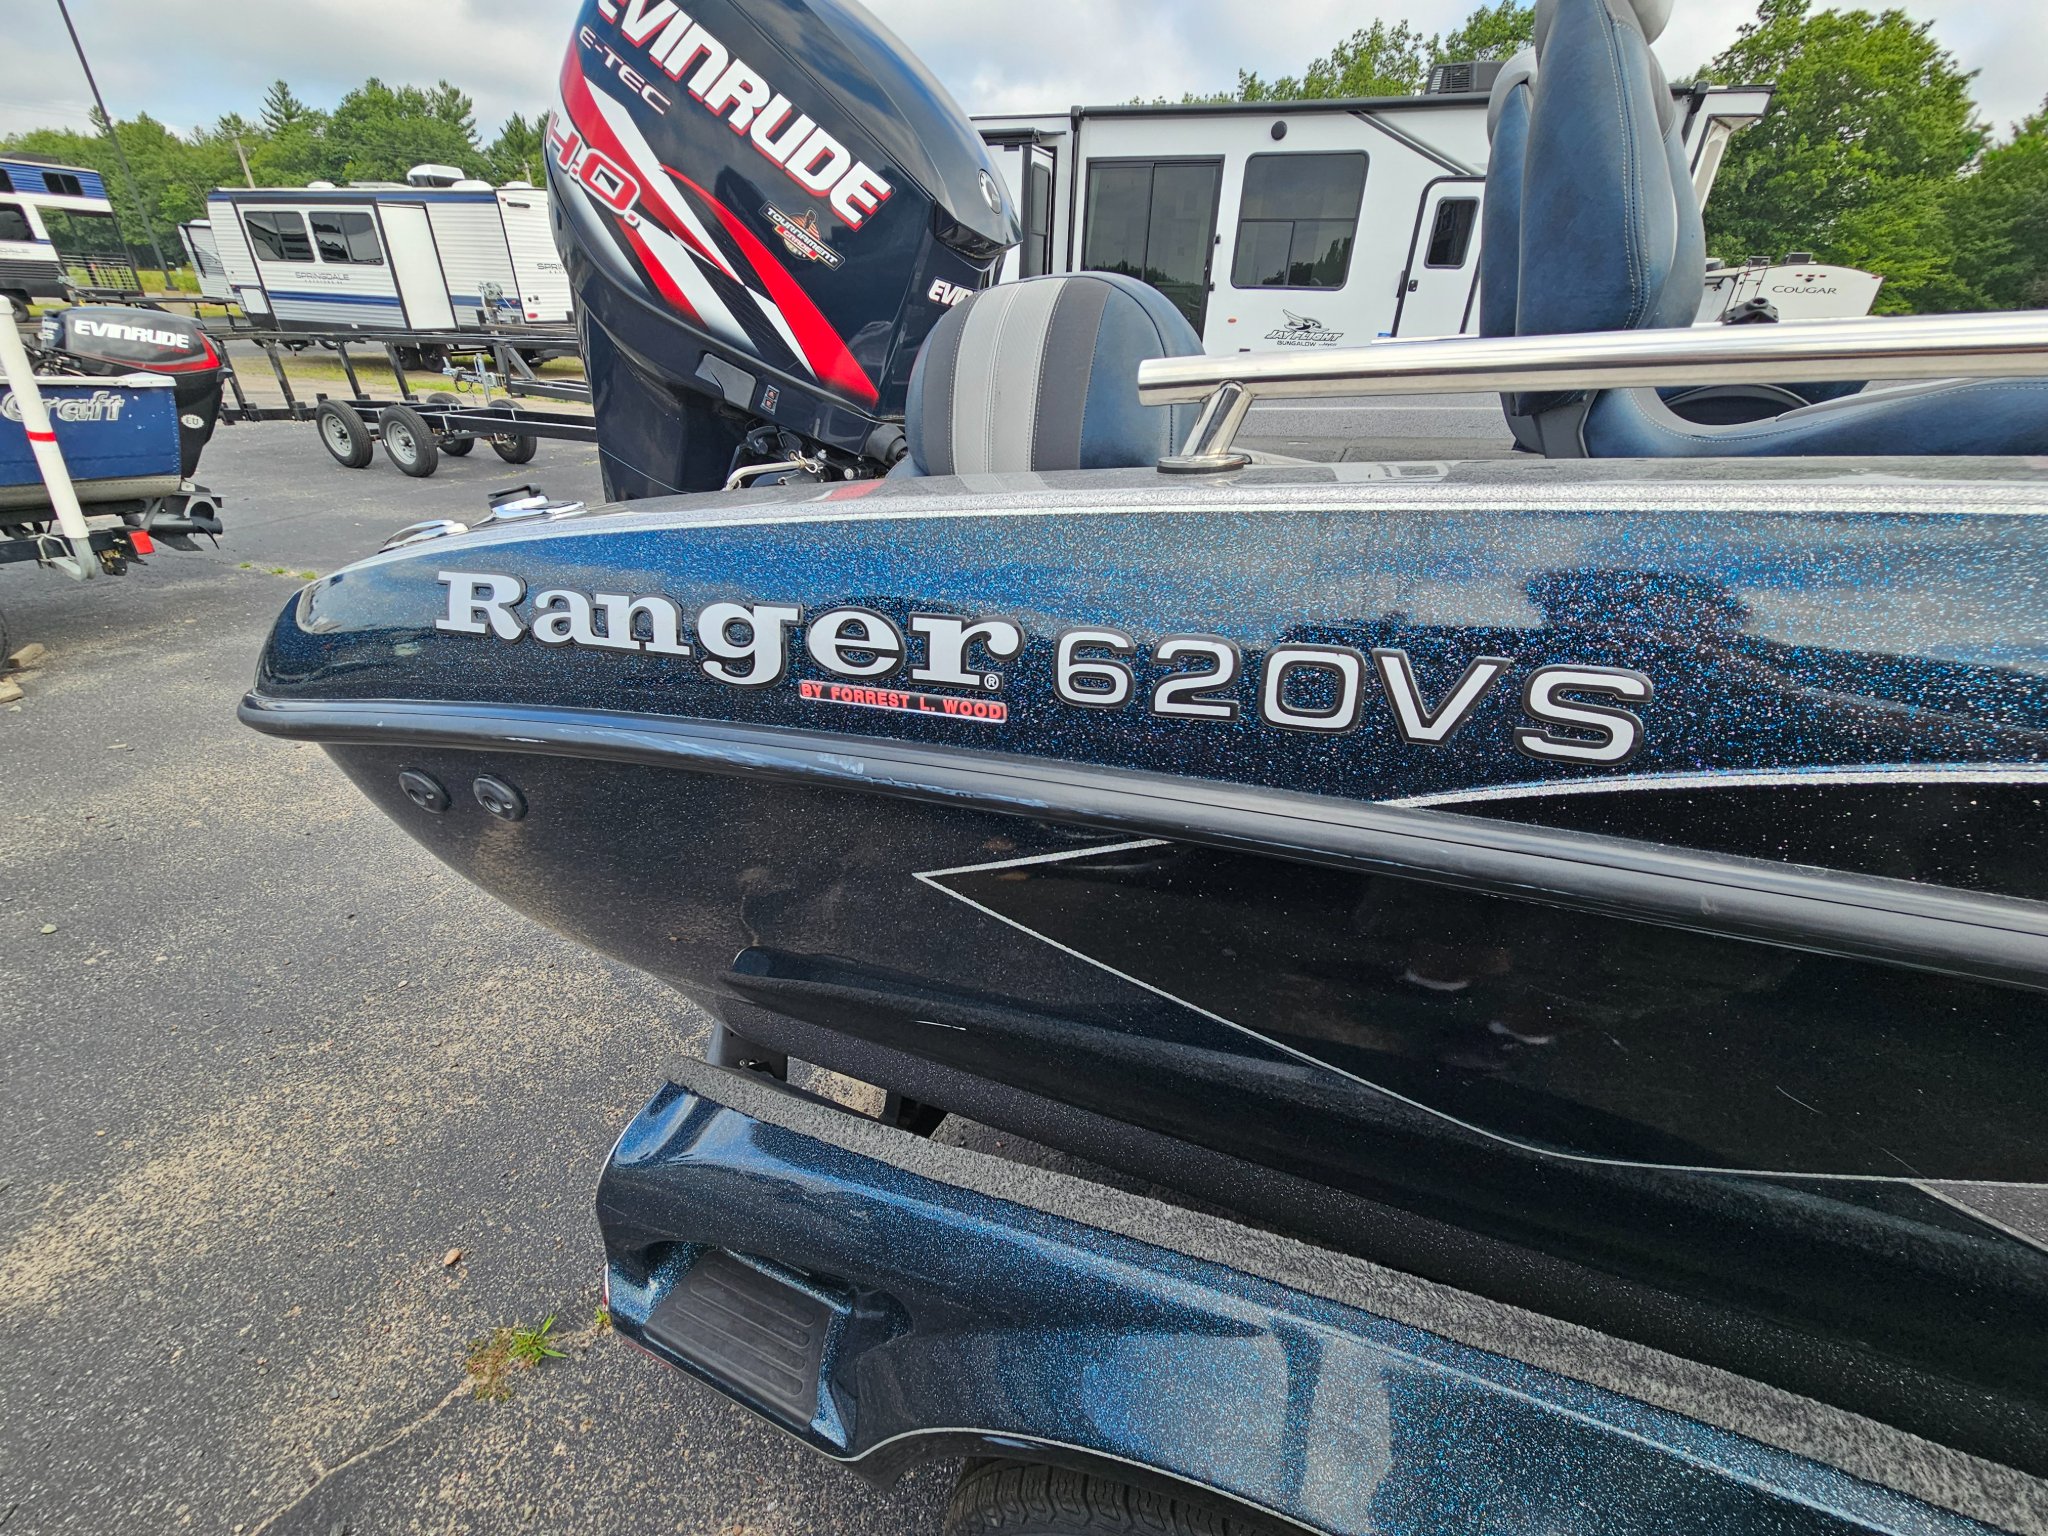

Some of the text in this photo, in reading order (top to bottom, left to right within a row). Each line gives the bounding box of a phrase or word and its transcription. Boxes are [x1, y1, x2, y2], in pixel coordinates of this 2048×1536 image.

[579, 25, 672, 116] E-TEC
[767, 206, 839, 263] TOURNAMENT
[1772, 285, 1838, 295] COUGAR
[74, 319, 190, 348] EVINRUDE
[435, 570, 1652, 764] Ranger 620VS
[801, 683, 1002, 719] BY FORREST L. WOOD
